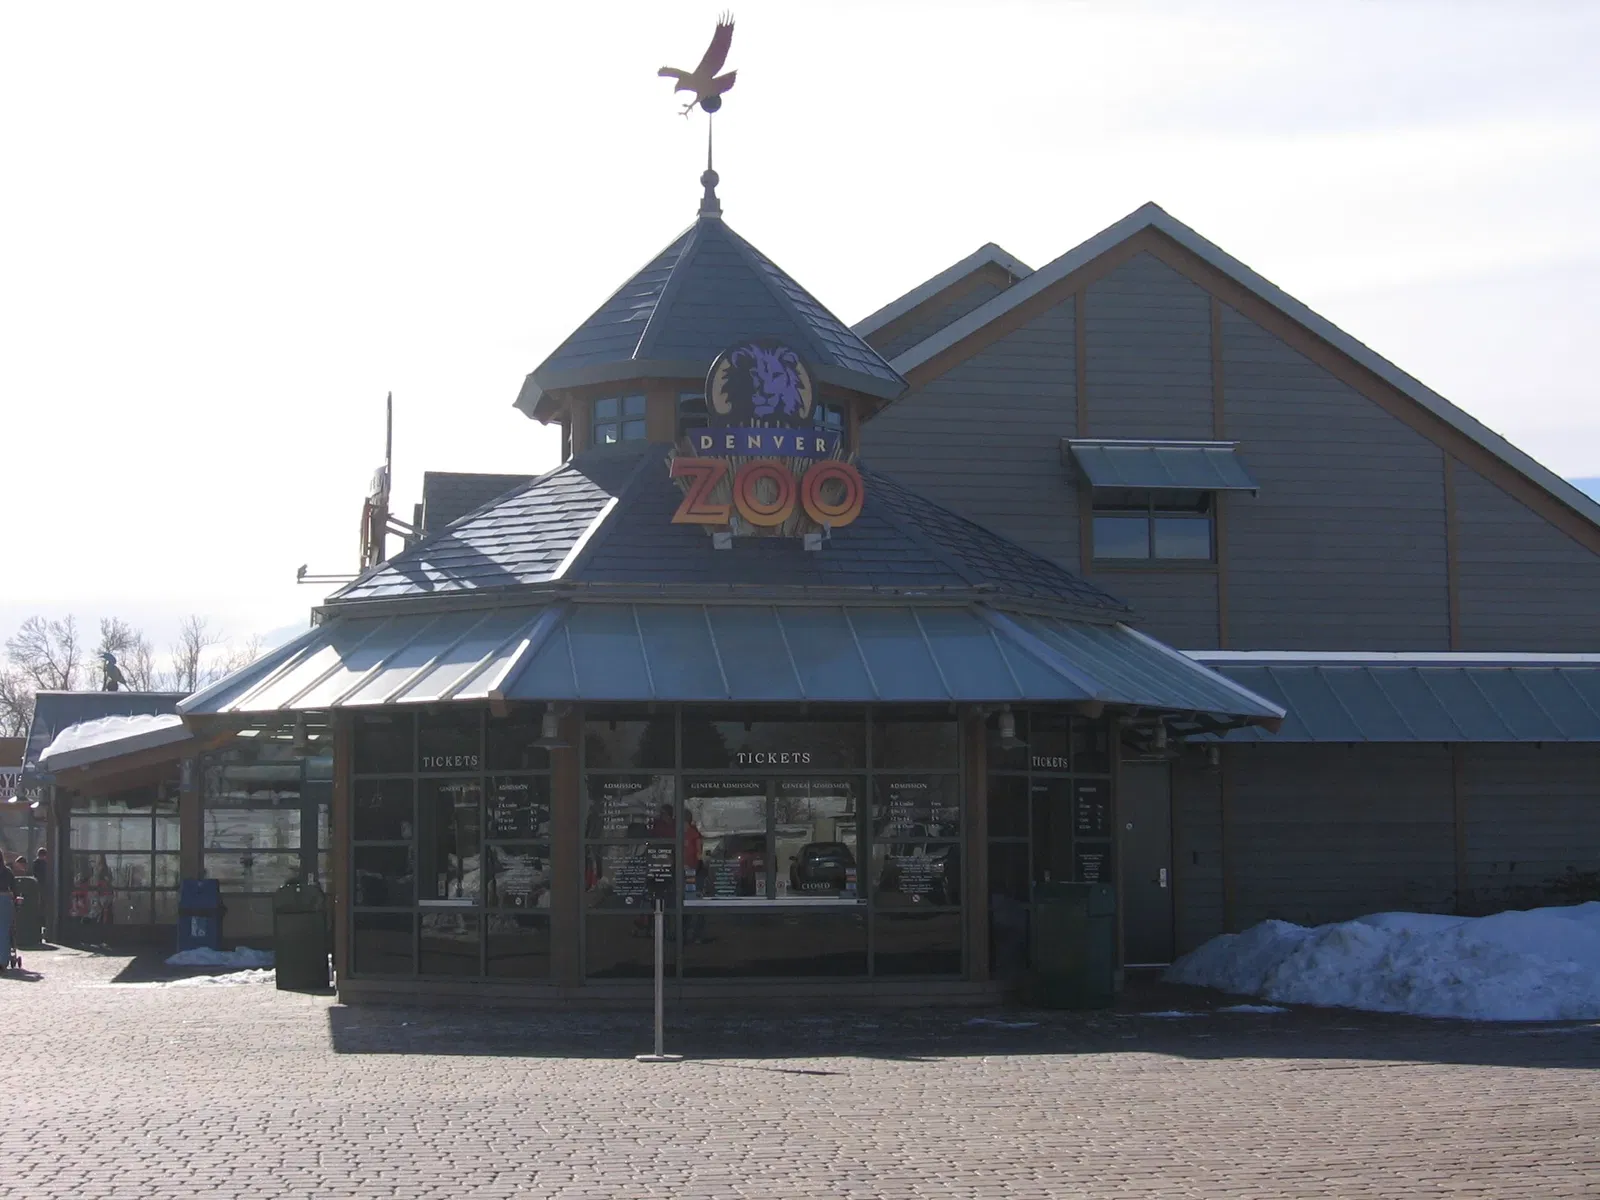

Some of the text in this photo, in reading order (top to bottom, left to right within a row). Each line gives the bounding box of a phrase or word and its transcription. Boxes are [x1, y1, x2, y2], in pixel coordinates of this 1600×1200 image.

[701, 435, 826, 453] DENVER
[669, 457, 864, 528] ZOO
[422, 754, 479, 768] TICKETS
[736, 752, 811, 764] TICKETS
[1032, 755, 1069, 769] TICKETS
[801, 881, 831, 890] CLOSED
